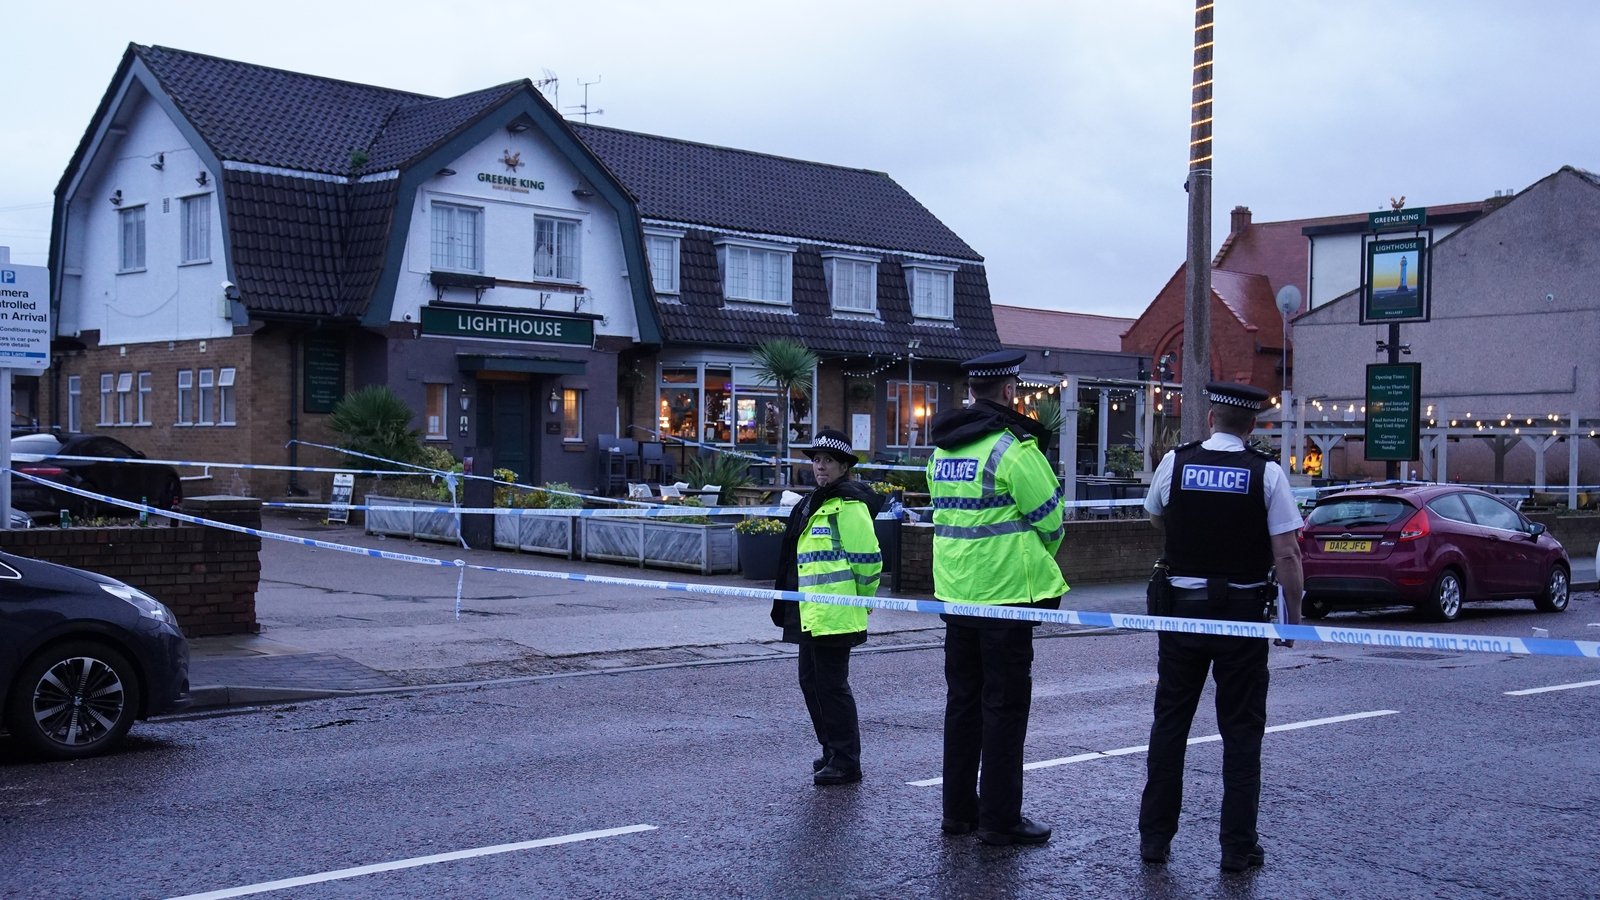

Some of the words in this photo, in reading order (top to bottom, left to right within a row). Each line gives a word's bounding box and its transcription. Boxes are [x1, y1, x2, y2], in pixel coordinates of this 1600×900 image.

[477, 173, 517, 186] GREENE
[520, 179, 545, 190] KING
[1374, 216, 1399, 224] GREENE
[1375, 242, 1417, 251] LIGHTHOUSE
[0, 299, 36, 310] trolled
[12, 312, 47, 322] Arrival
[458, 315, 562, 337] LIGHTHOUSE
[935, 461, 976, 478] POLICE
[1185, 468, 1248, 490] POLICE
[1330, 542, 1348, 550] DA12
[1350, 542, 1366, 550] JFG
